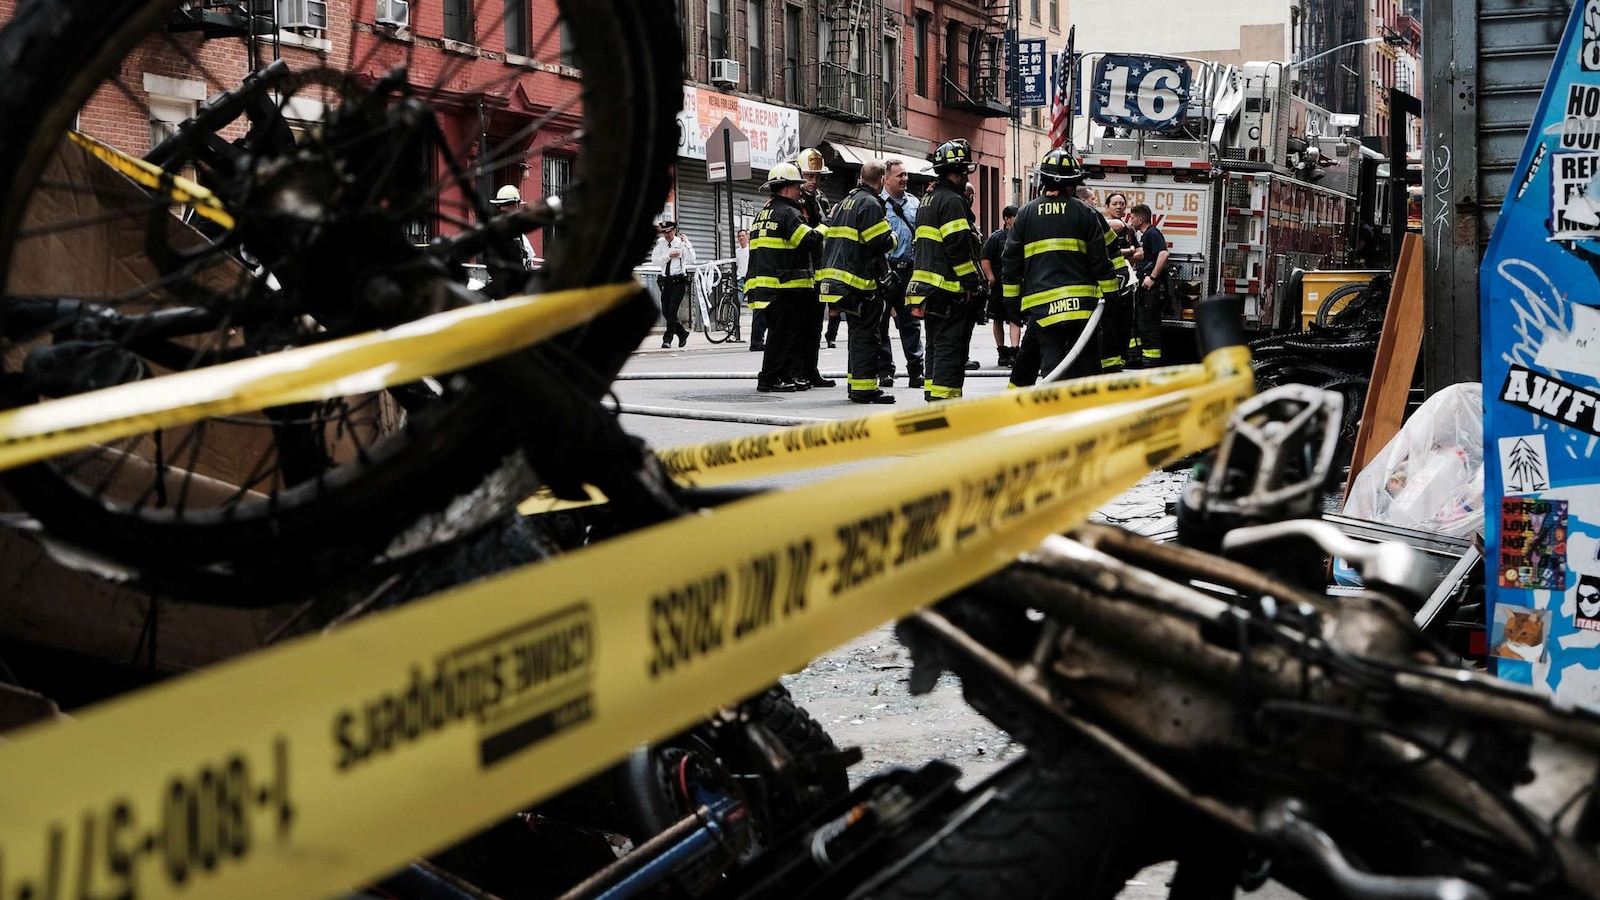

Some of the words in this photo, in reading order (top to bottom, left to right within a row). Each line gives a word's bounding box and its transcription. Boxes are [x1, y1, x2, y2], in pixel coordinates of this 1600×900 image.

[1100, 66, 1181, 121] 16
[1038, 203, 1067, 216] FDNY
[1183, 193, 1199, 212] 16
[1048, 298, 1080, 315] AHMED
[516, 622, 586, 694] CRIME
